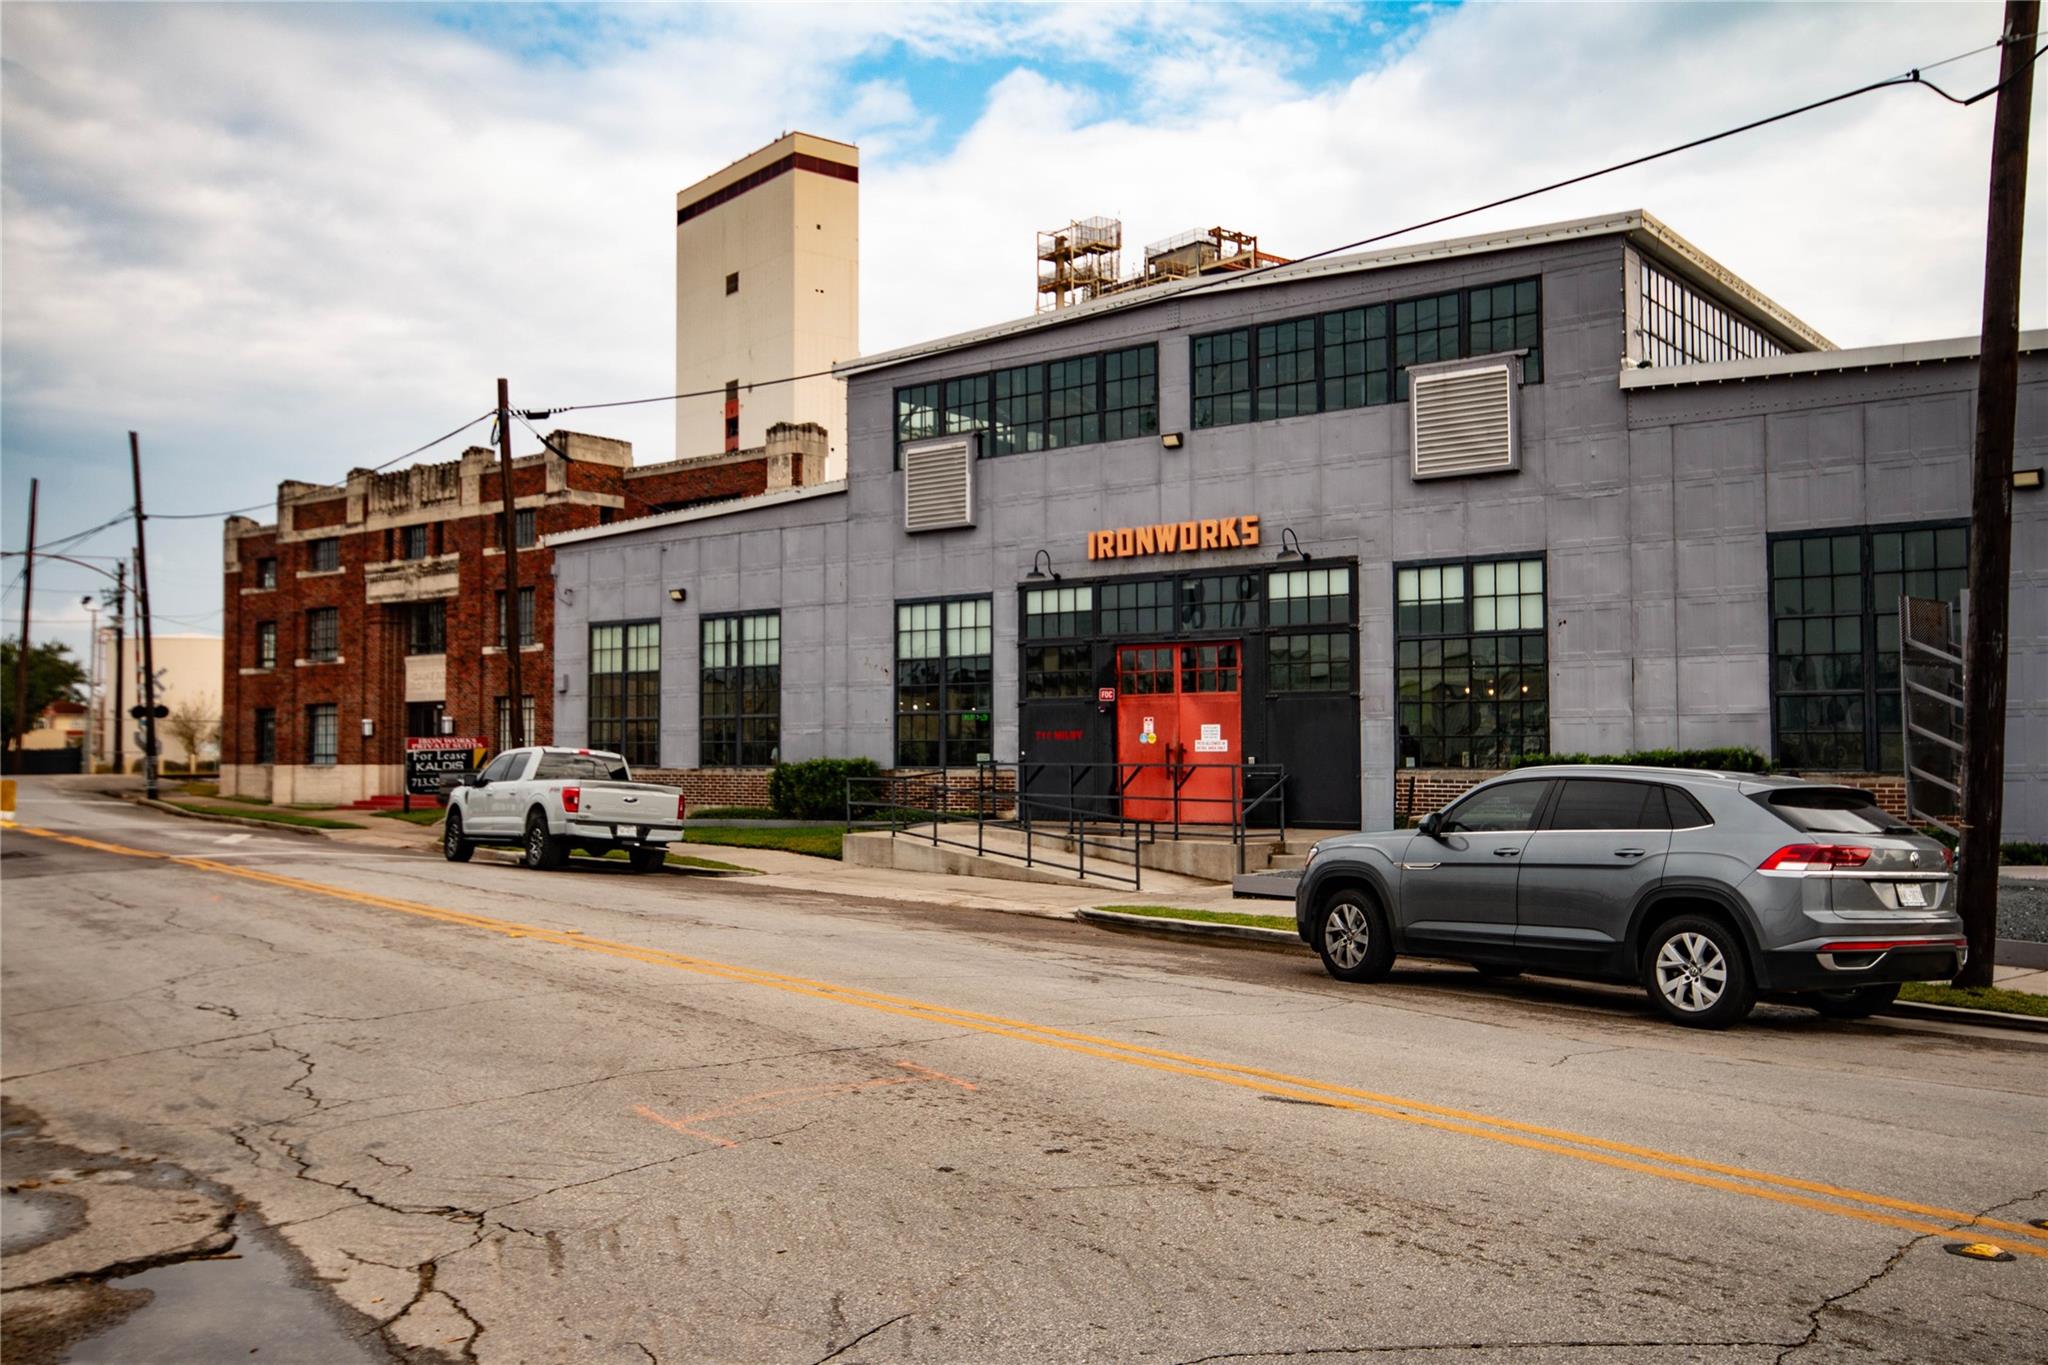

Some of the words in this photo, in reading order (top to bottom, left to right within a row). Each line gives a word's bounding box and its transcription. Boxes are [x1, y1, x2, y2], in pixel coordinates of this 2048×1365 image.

[1088, 515, 1260, 561] IRONWORKS
[1101, 690, 1113, 699] FDC
[413, 750, 433, 761] For
[436, 749, 467, 760] Lease
[415, 761, 465, 771] KALDIS
